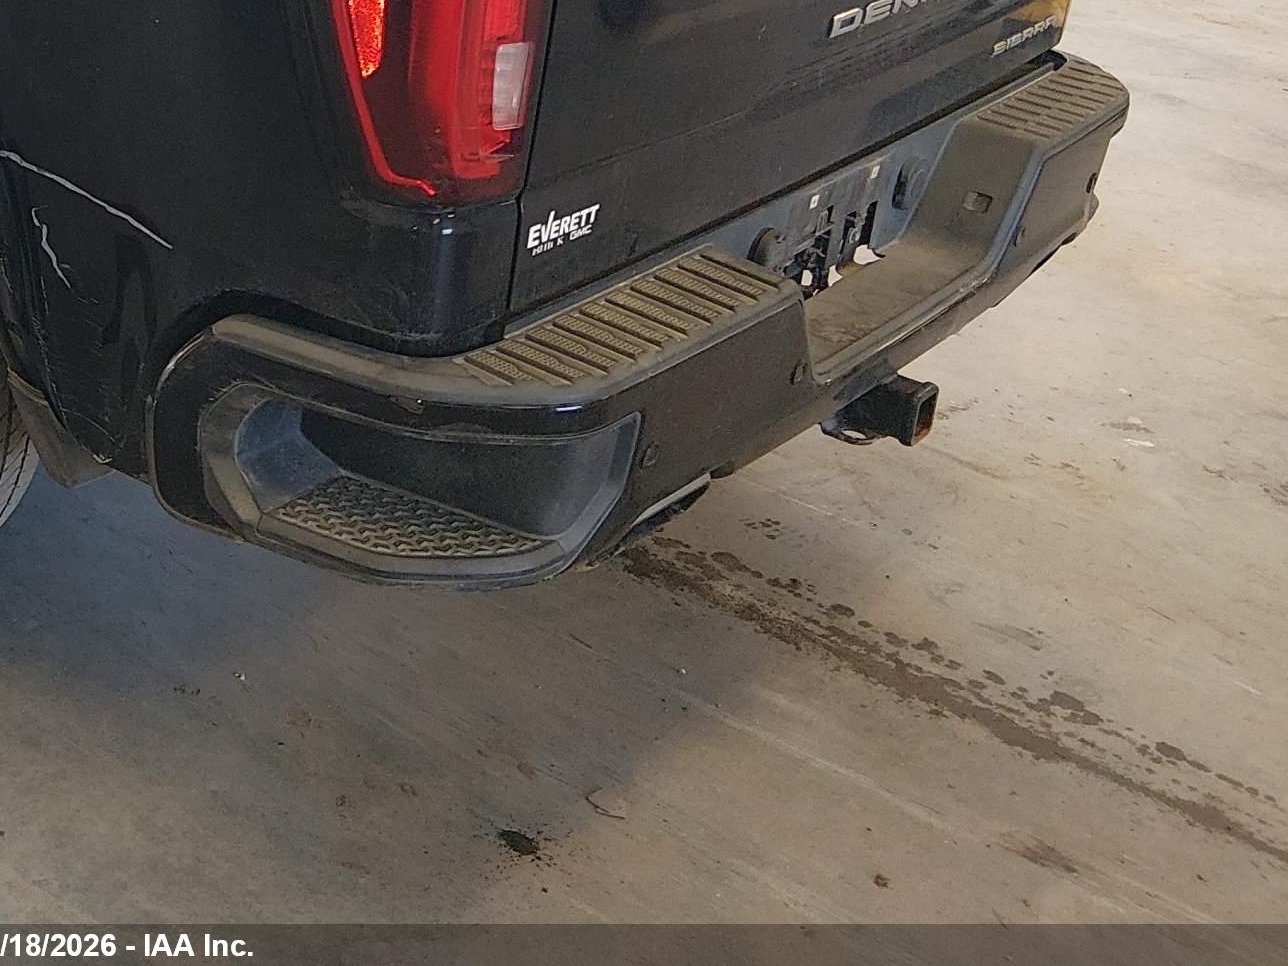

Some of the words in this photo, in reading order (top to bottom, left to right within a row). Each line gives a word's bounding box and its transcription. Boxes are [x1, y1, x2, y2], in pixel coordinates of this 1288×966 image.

[991, 15, 1057, 58] SIERRA
[527, 203, 600, 249] EVERETT
[569, 224, 593, 241] GMC
